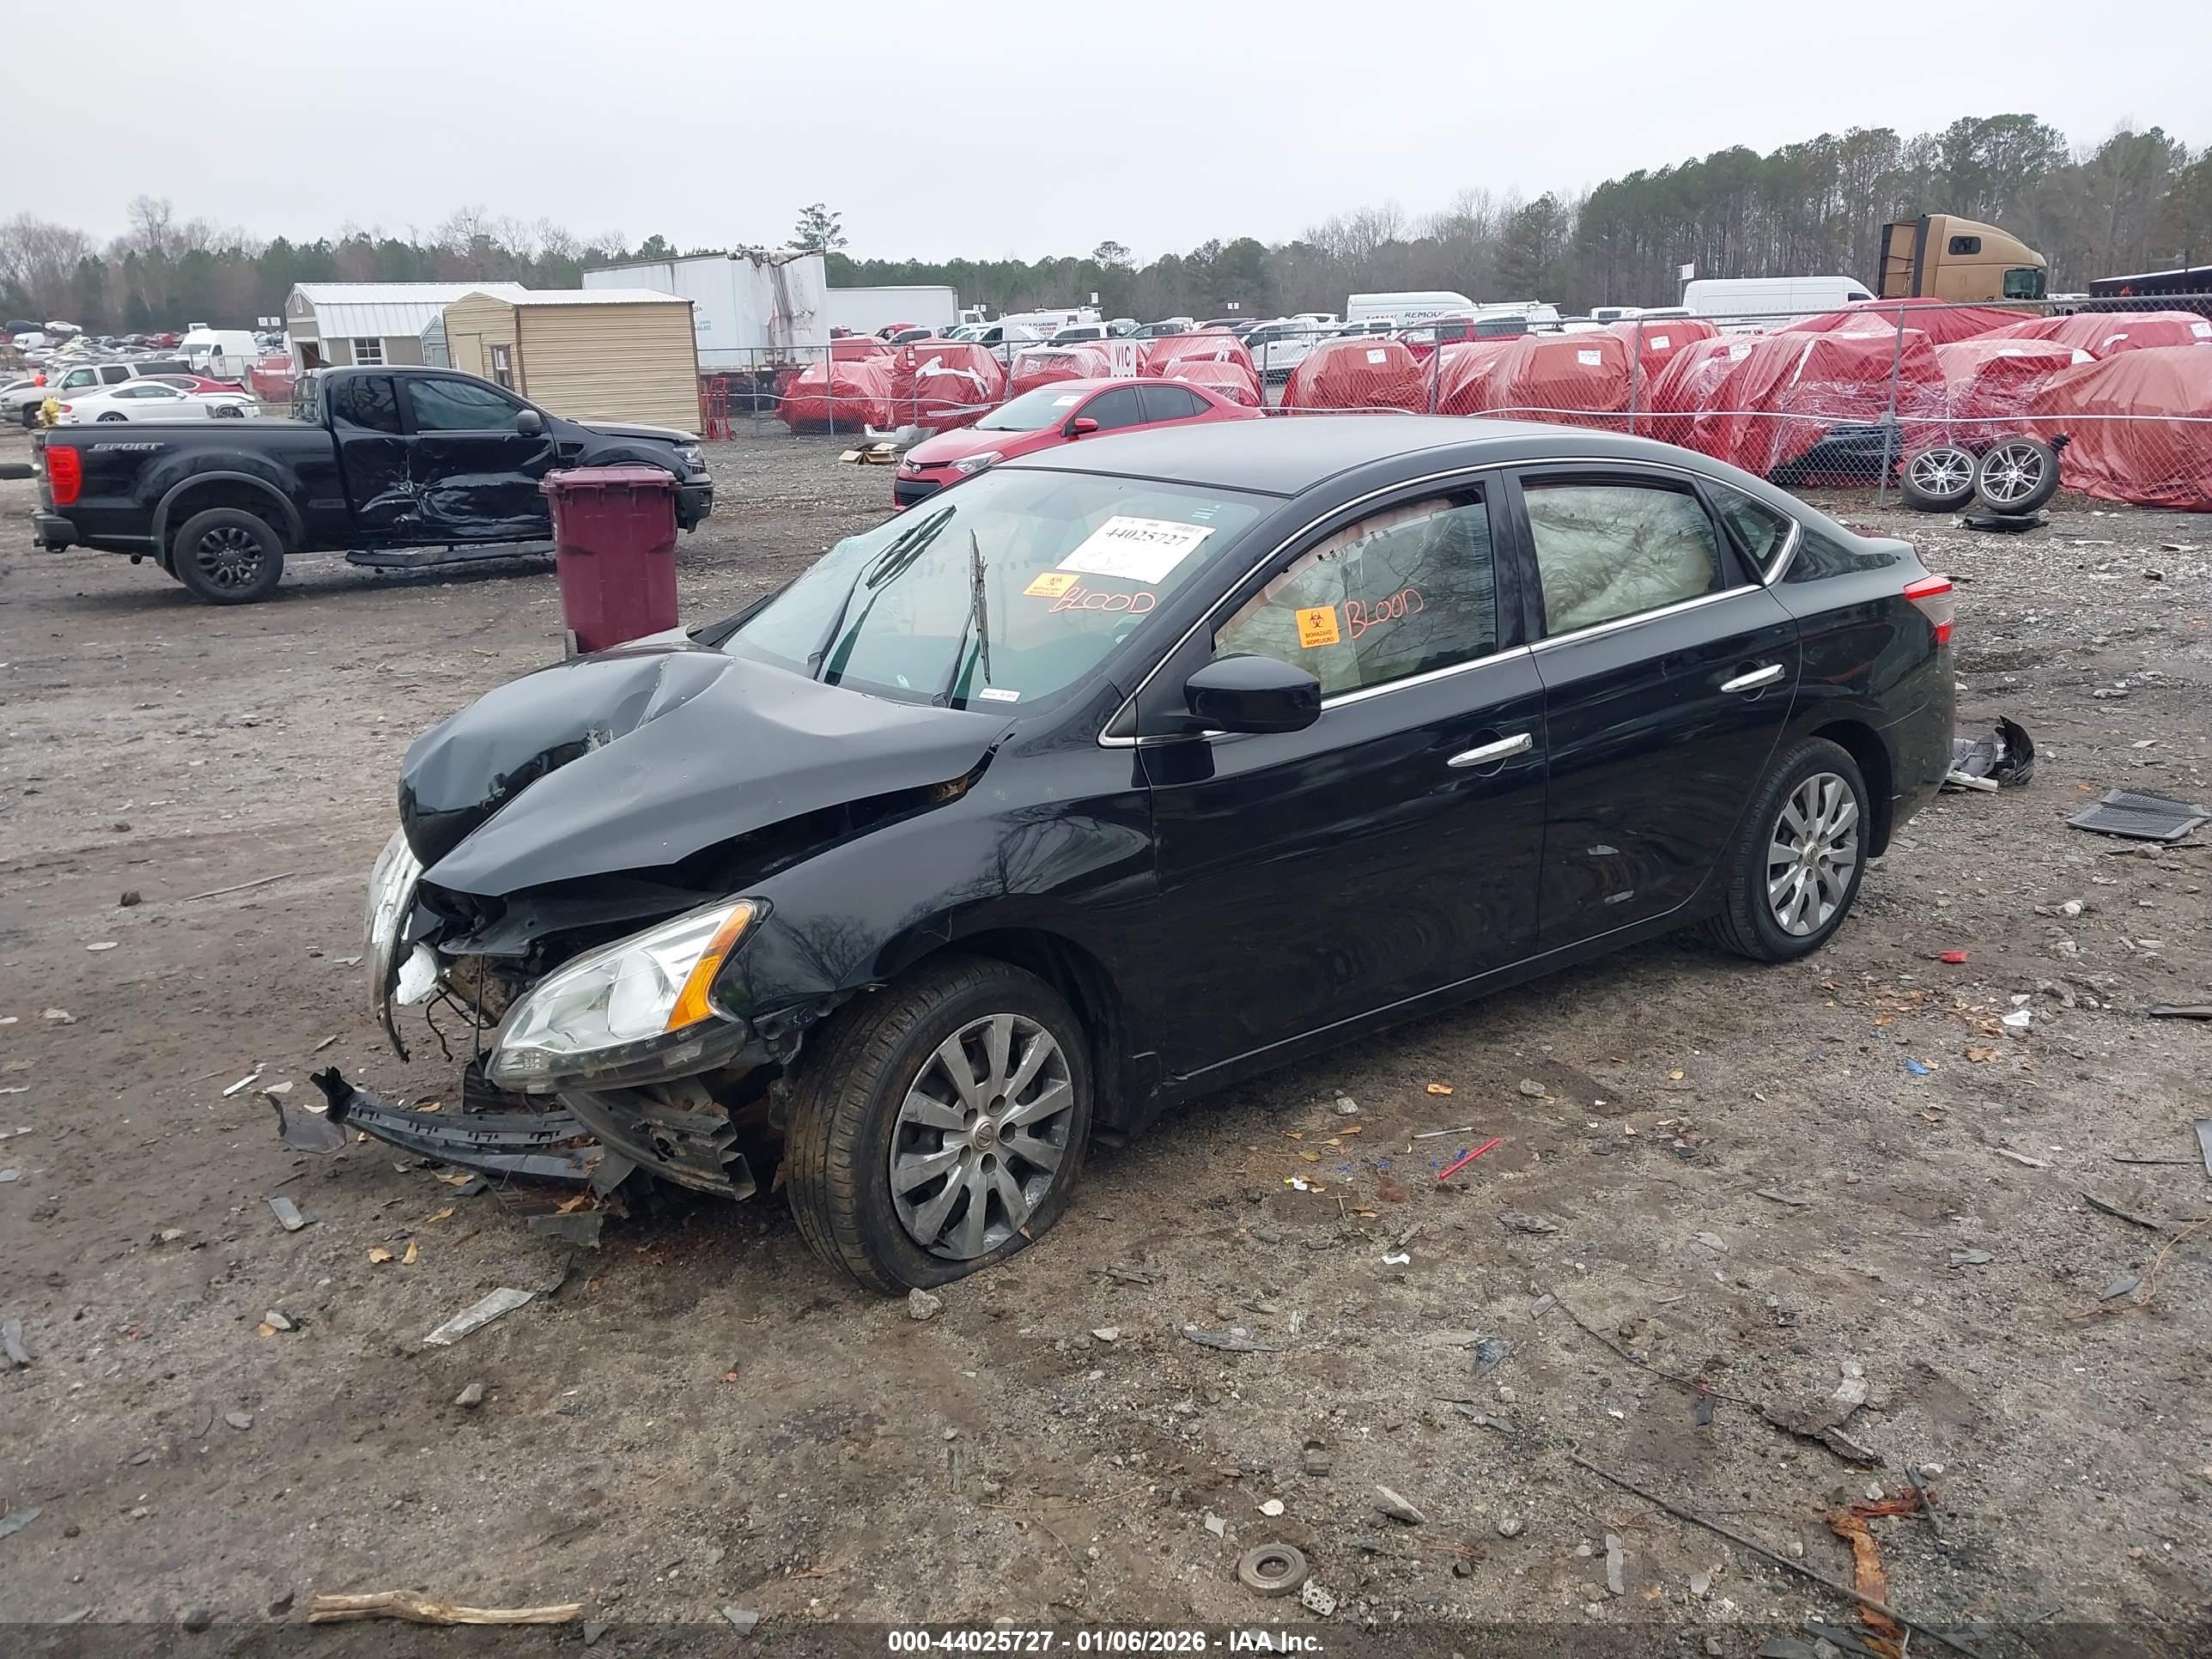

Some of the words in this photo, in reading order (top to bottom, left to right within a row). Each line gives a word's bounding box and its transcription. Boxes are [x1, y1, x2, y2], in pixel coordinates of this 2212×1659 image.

[1115, 345, 1131, 368] VIC
[87, 441, 164, 453] SPORT
[1109, 527, 1189, 546] 44025727
[1048, 586, 1156, 614] BLOOD
[1345, 588, 1425, 639] BLOOD
[1304, 629, 1334, 639] BIOHAZARD
[1305, 636, 1334, 646] BIOPELIGRO
